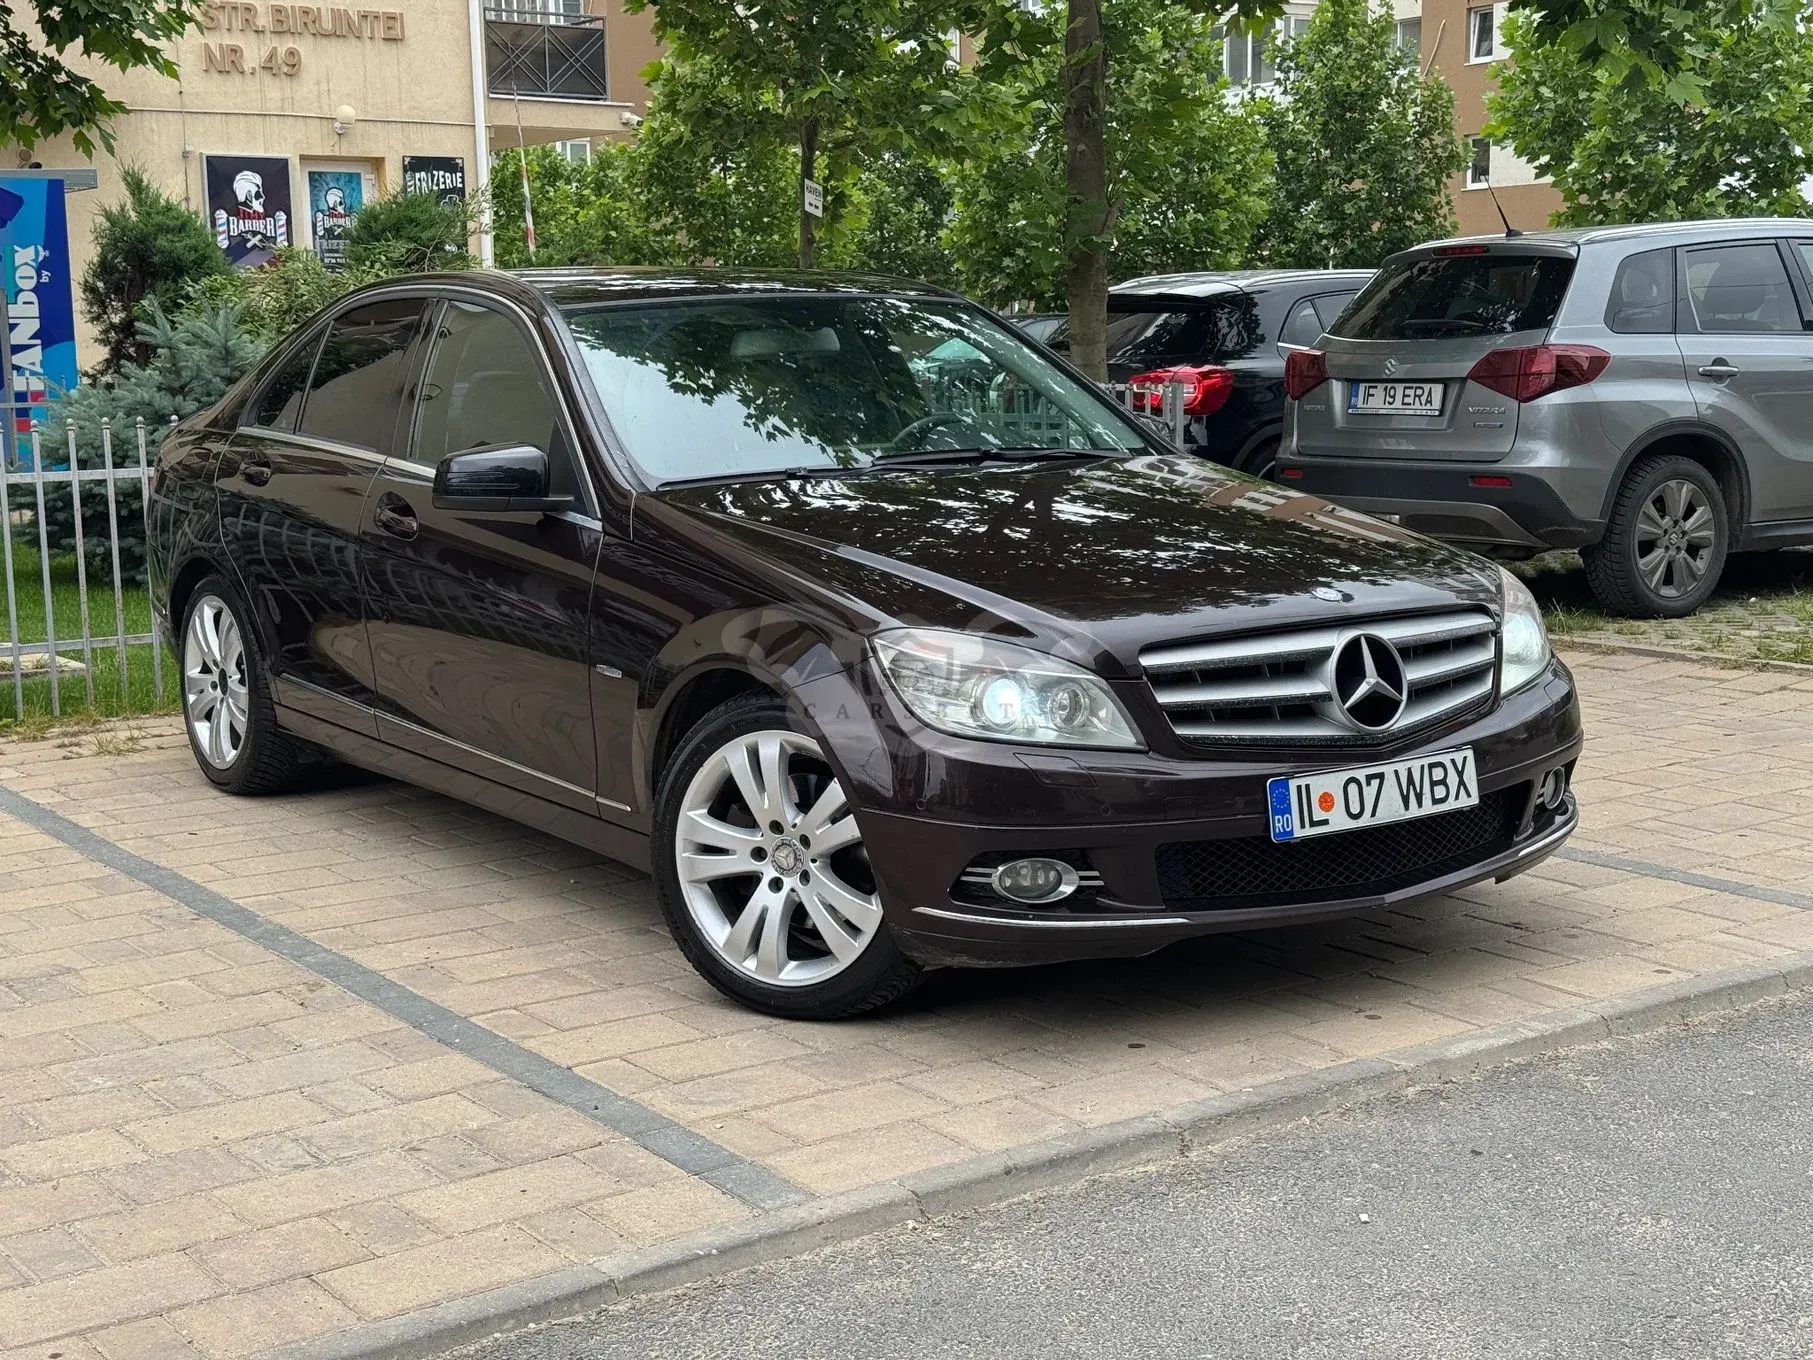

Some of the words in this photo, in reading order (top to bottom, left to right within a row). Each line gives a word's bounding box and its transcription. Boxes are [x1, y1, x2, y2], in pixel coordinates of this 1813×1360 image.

[415, 170, 464, 195] FRIZERIE
[228, 216, 276, 237] BARBER
[40, 269, 51, 283] by
[1362, 385, 1378, 406] IF
[1383, 385, 1397, 406] 19
[1401, 385, 1433, 407] ERA
[1296, 783, 1330, 829] IL
[1342, 771, 1386, 821] 07
[1393, 756, 1472, 812] WBX
[1275, 813, 1292, 833] RO
